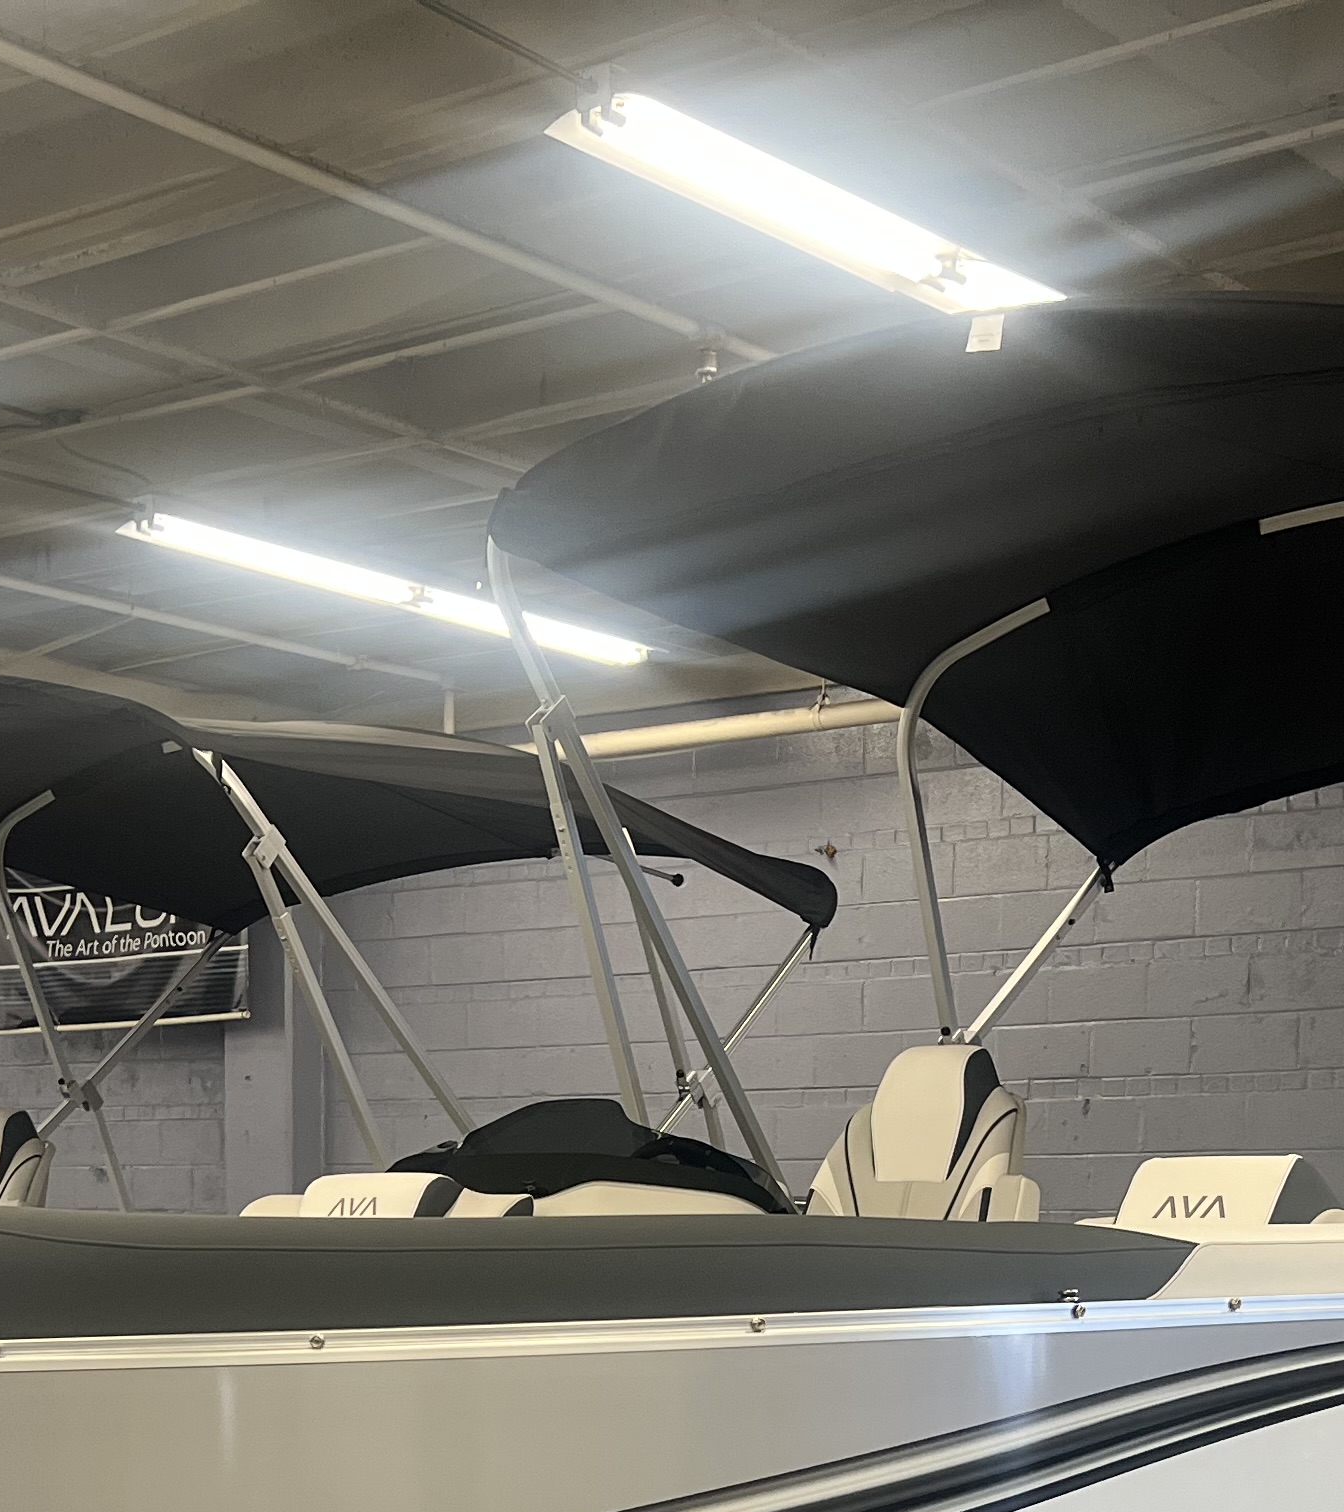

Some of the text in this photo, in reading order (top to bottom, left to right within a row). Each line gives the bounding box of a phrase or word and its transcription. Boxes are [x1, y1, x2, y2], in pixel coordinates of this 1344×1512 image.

[46, 930, 206, 958] The Art of the Pontoon
[327, 1196, 377, 1217] AVA
[1152, 1195, 1226, 1219] AVA
